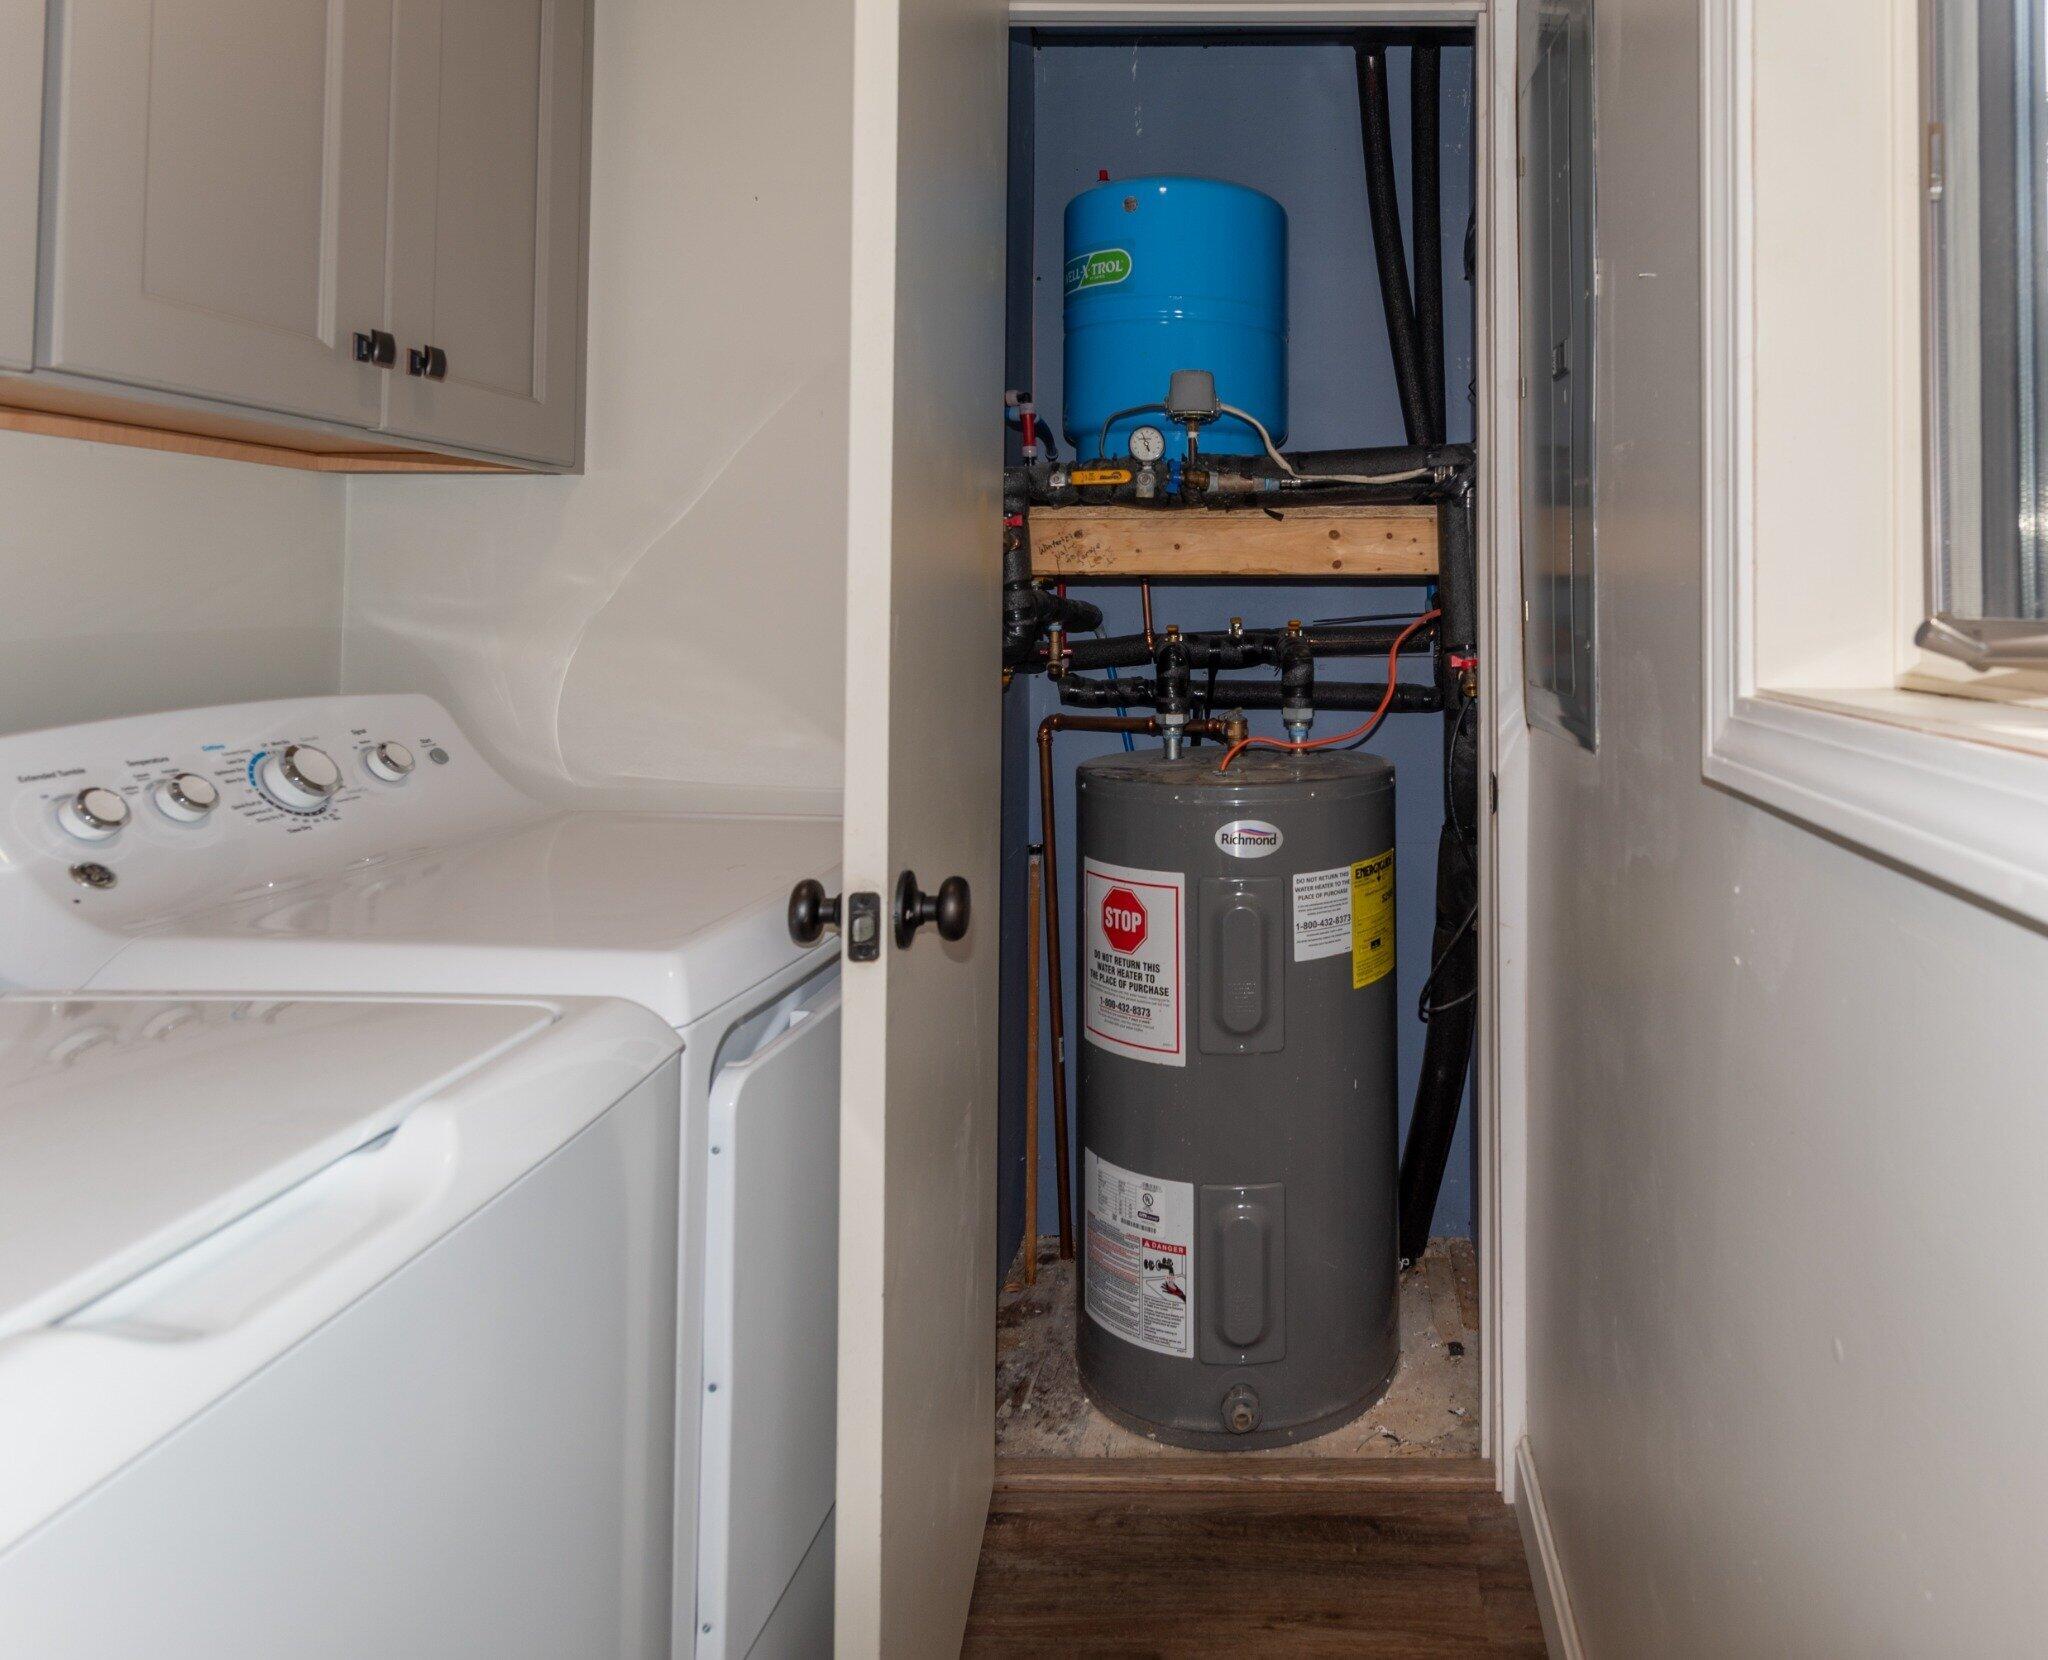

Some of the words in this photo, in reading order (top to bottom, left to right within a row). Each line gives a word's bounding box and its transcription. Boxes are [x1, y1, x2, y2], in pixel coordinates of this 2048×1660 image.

[17, 771, 56, 783] Extended
[1221, 833, 1277, 847] Richmond
[1295, 885, 1314, 893] WATER
[1297, 893, 1315, 901] PLACE
[1105, 906, 1142, 933] STOP
[1296, 914, 1351, 930] 1-800-432-8373
[1094, 949, 1101, 960] DO
[1102, 952, 1113, 963] NOT
[1114, 956, 1141, 970] RETURN
[1143, 962, 1160, 973] THIS
[1097, 962, 1116, 976] WATER
[1116, 968, 1143, 982] HEATER
[1145, 974, 1155, 984] TO
[1090, 968, 1099, 981] THE
[1099, 972, 1117, 987] PLACE
[1118, 979, 1128, 989] OF
[1128, 981, 1170, 997] PURCHASE
[1099, 996, 1151, 1017] 1-800-432-8373
[1152, 1242, 1185, 1254] DANGER
